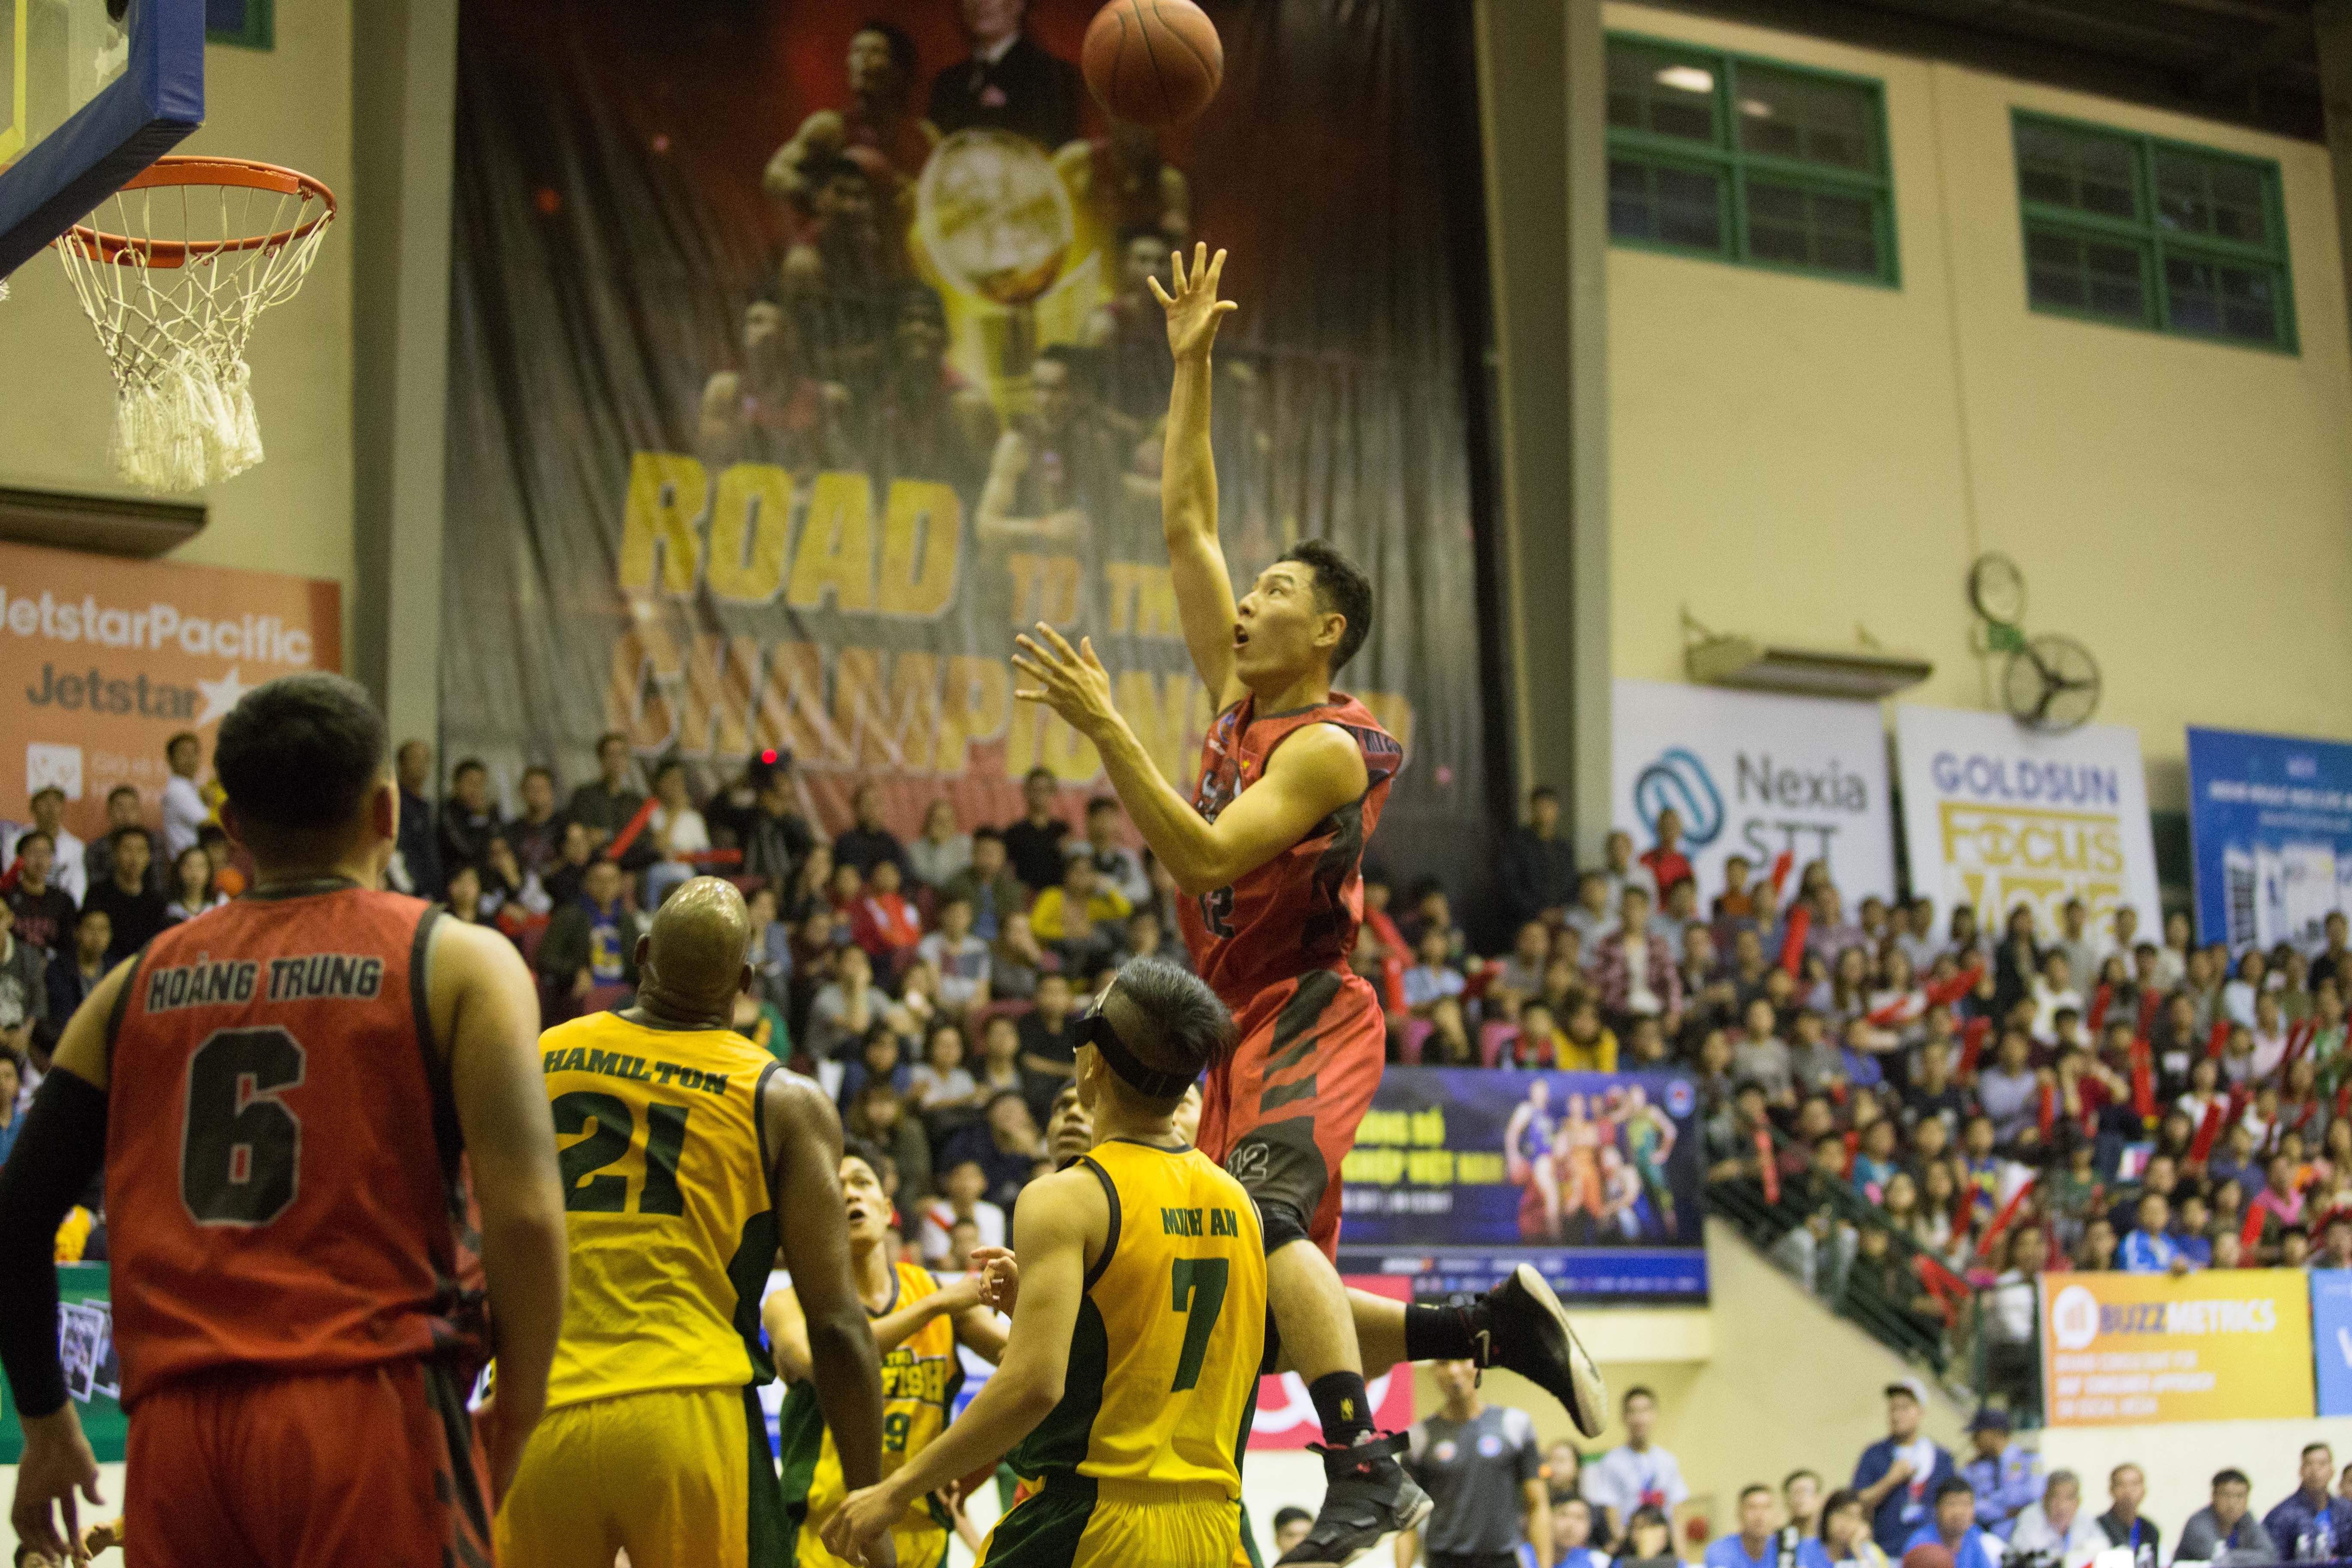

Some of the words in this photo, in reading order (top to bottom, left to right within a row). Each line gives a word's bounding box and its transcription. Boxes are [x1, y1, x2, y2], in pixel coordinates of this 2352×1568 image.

[619, 450, 962, 619] ROAD
[1008, 553, 1081, 630] TO
[1106, 560, 1184, 637] TH
[26, 663, 199, 721] Jetstar
[1735, 750, 1867, 813] Nexia
[1932, 751, 2119, 804] GOLDSUN
[1743, 817, 1841, 870] STT
[265, 952, 385, 1002] TRUNG
[543, 1047, 730, 1095] HAMILTON
[177, 1024, 306, 1228] 6
[551, 1091, 689, 1218] 21
[1210, 1207, 1239, 1238] AN
[1171, 1257, 1229, 1393] 7
